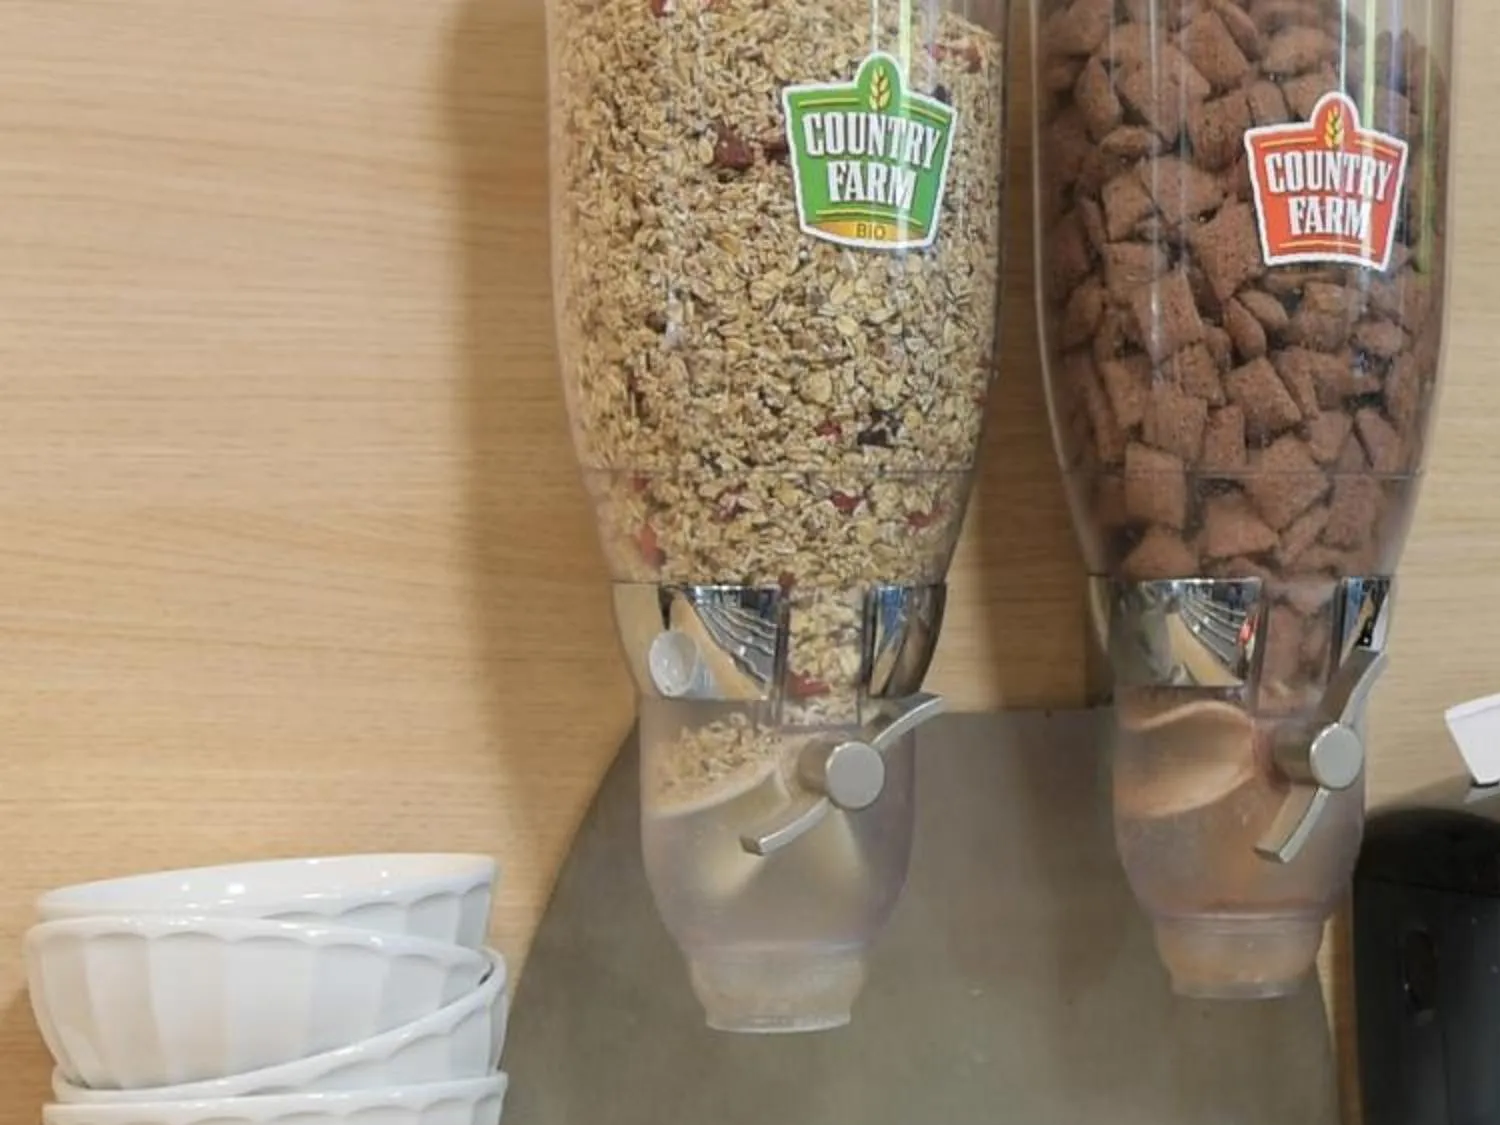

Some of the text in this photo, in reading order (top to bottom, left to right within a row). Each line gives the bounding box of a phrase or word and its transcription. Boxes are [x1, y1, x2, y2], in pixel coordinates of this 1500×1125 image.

[802, 111, 941, 169] COUNTRY
[827, 160, 917, 210] FARM
[1264, 150, 1393, 200] COUNTRY
[855, 223, 886, 240] BIO
[1287, 195, 1371, 239] FARM
